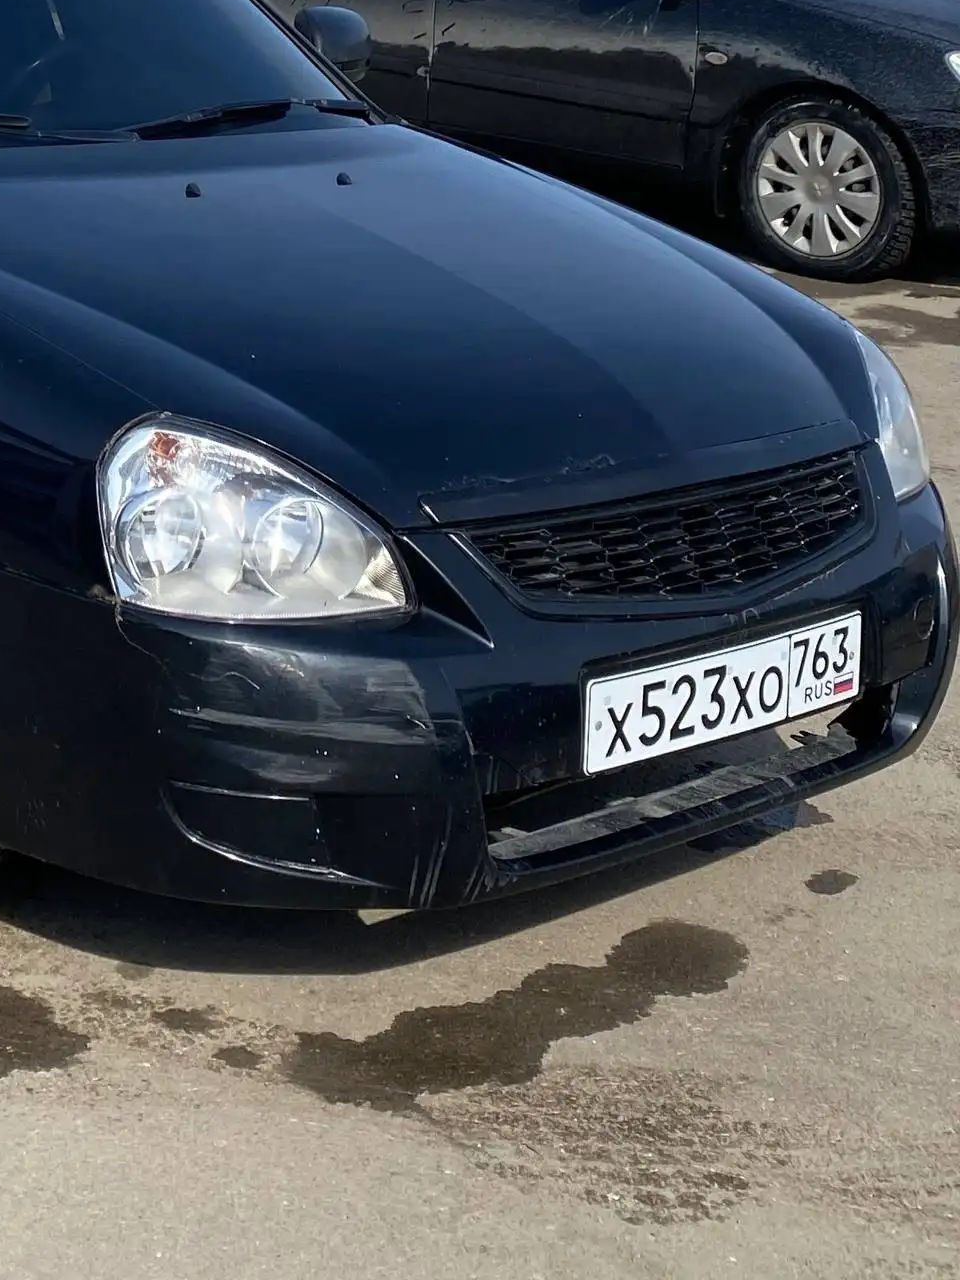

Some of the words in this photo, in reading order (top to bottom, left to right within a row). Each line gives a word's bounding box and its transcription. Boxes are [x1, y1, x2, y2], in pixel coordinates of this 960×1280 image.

[605, 665, 783, 758] Х523ХО
[793, 625, 850, 688] 763
[804, 680, 833, 705] RUS
